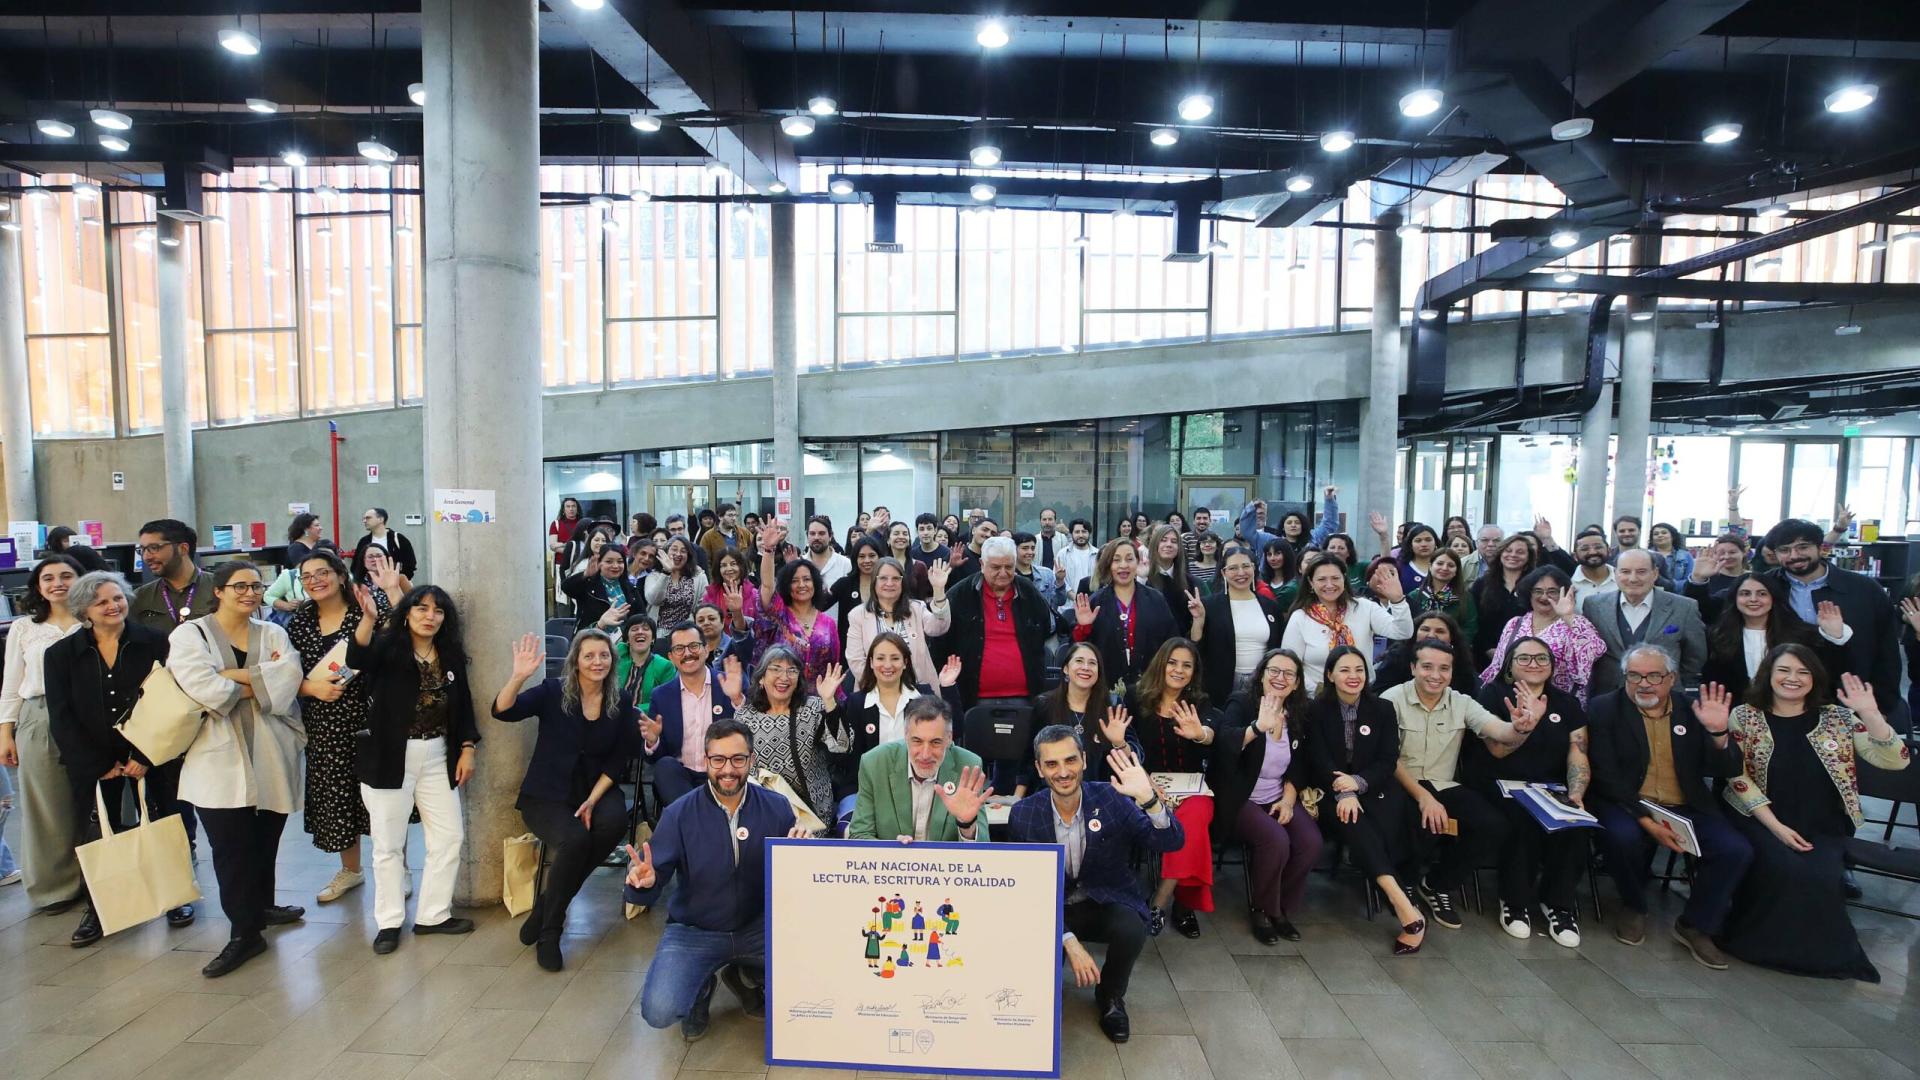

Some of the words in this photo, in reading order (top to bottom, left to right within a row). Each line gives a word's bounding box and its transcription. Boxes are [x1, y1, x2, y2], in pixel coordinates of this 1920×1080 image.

[846, 860, 878, 871] PLAN
[881, 861, 945, 873] NACIONAL
[948, 863, 964, 873] DE
[967, 863, 982, 873] LA
[812, 873, 870, 885] LECTURA,
[873, 875, 941, 886] ESCRITURA
[943, 876, 951, 886] Y
[953, 877, 1016, 888] ORALIDAD
